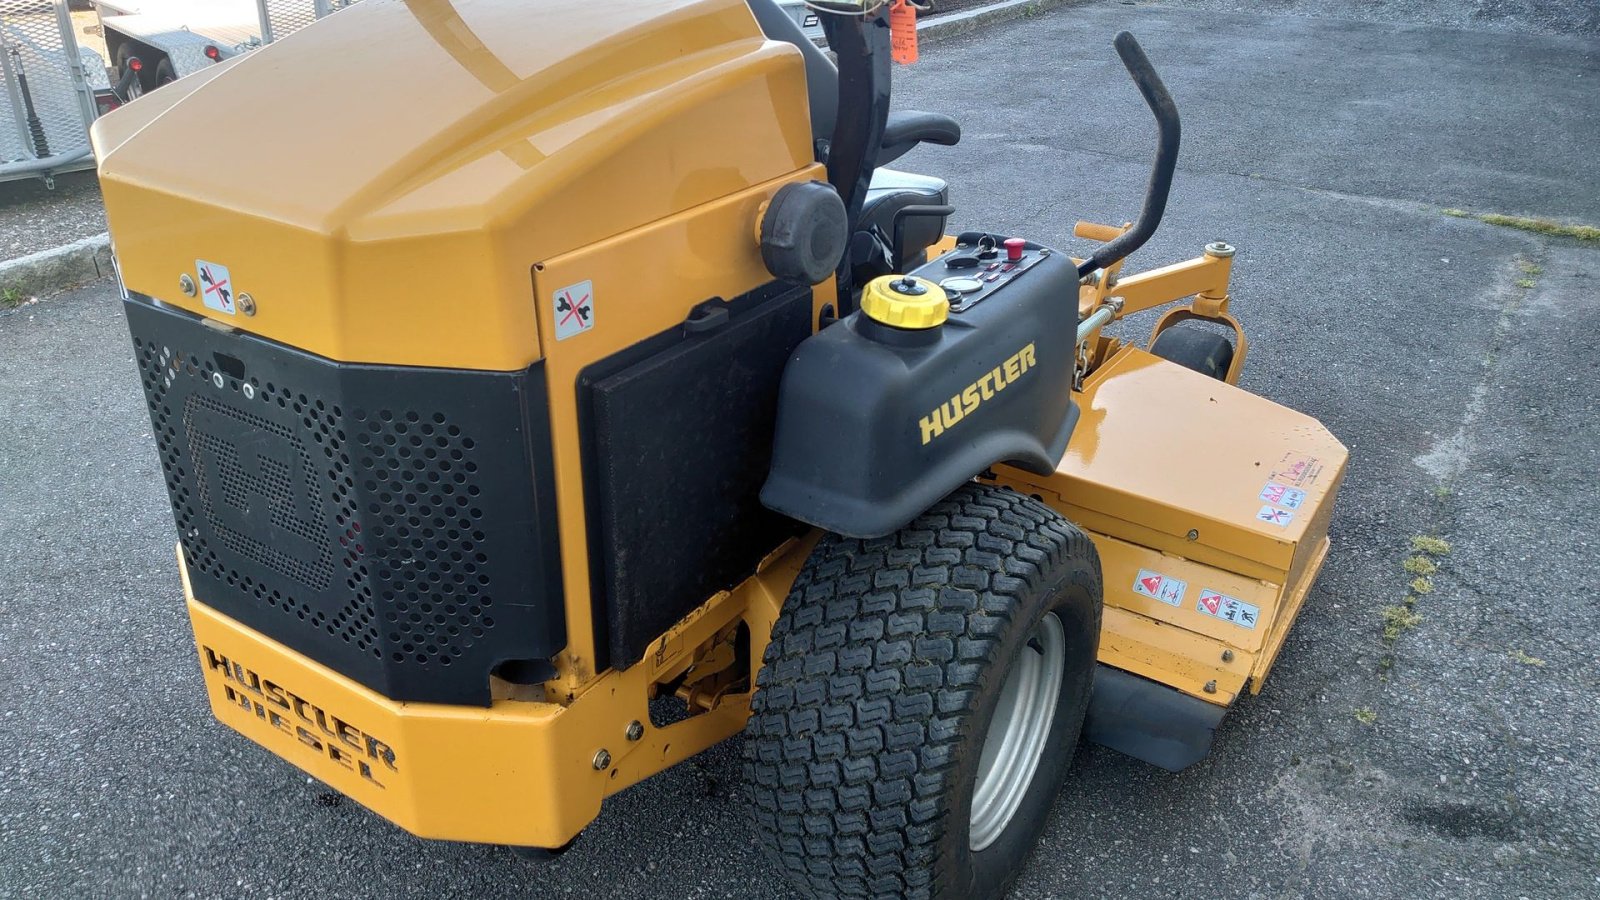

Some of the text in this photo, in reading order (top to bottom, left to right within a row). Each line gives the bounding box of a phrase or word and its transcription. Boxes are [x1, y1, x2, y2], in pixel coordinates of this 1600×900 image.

[918, 342, 1036, 445] HUSTLER
[203, 645, 398, 773] HUSTLER
[224, 684, 386, 790] DIESEL
